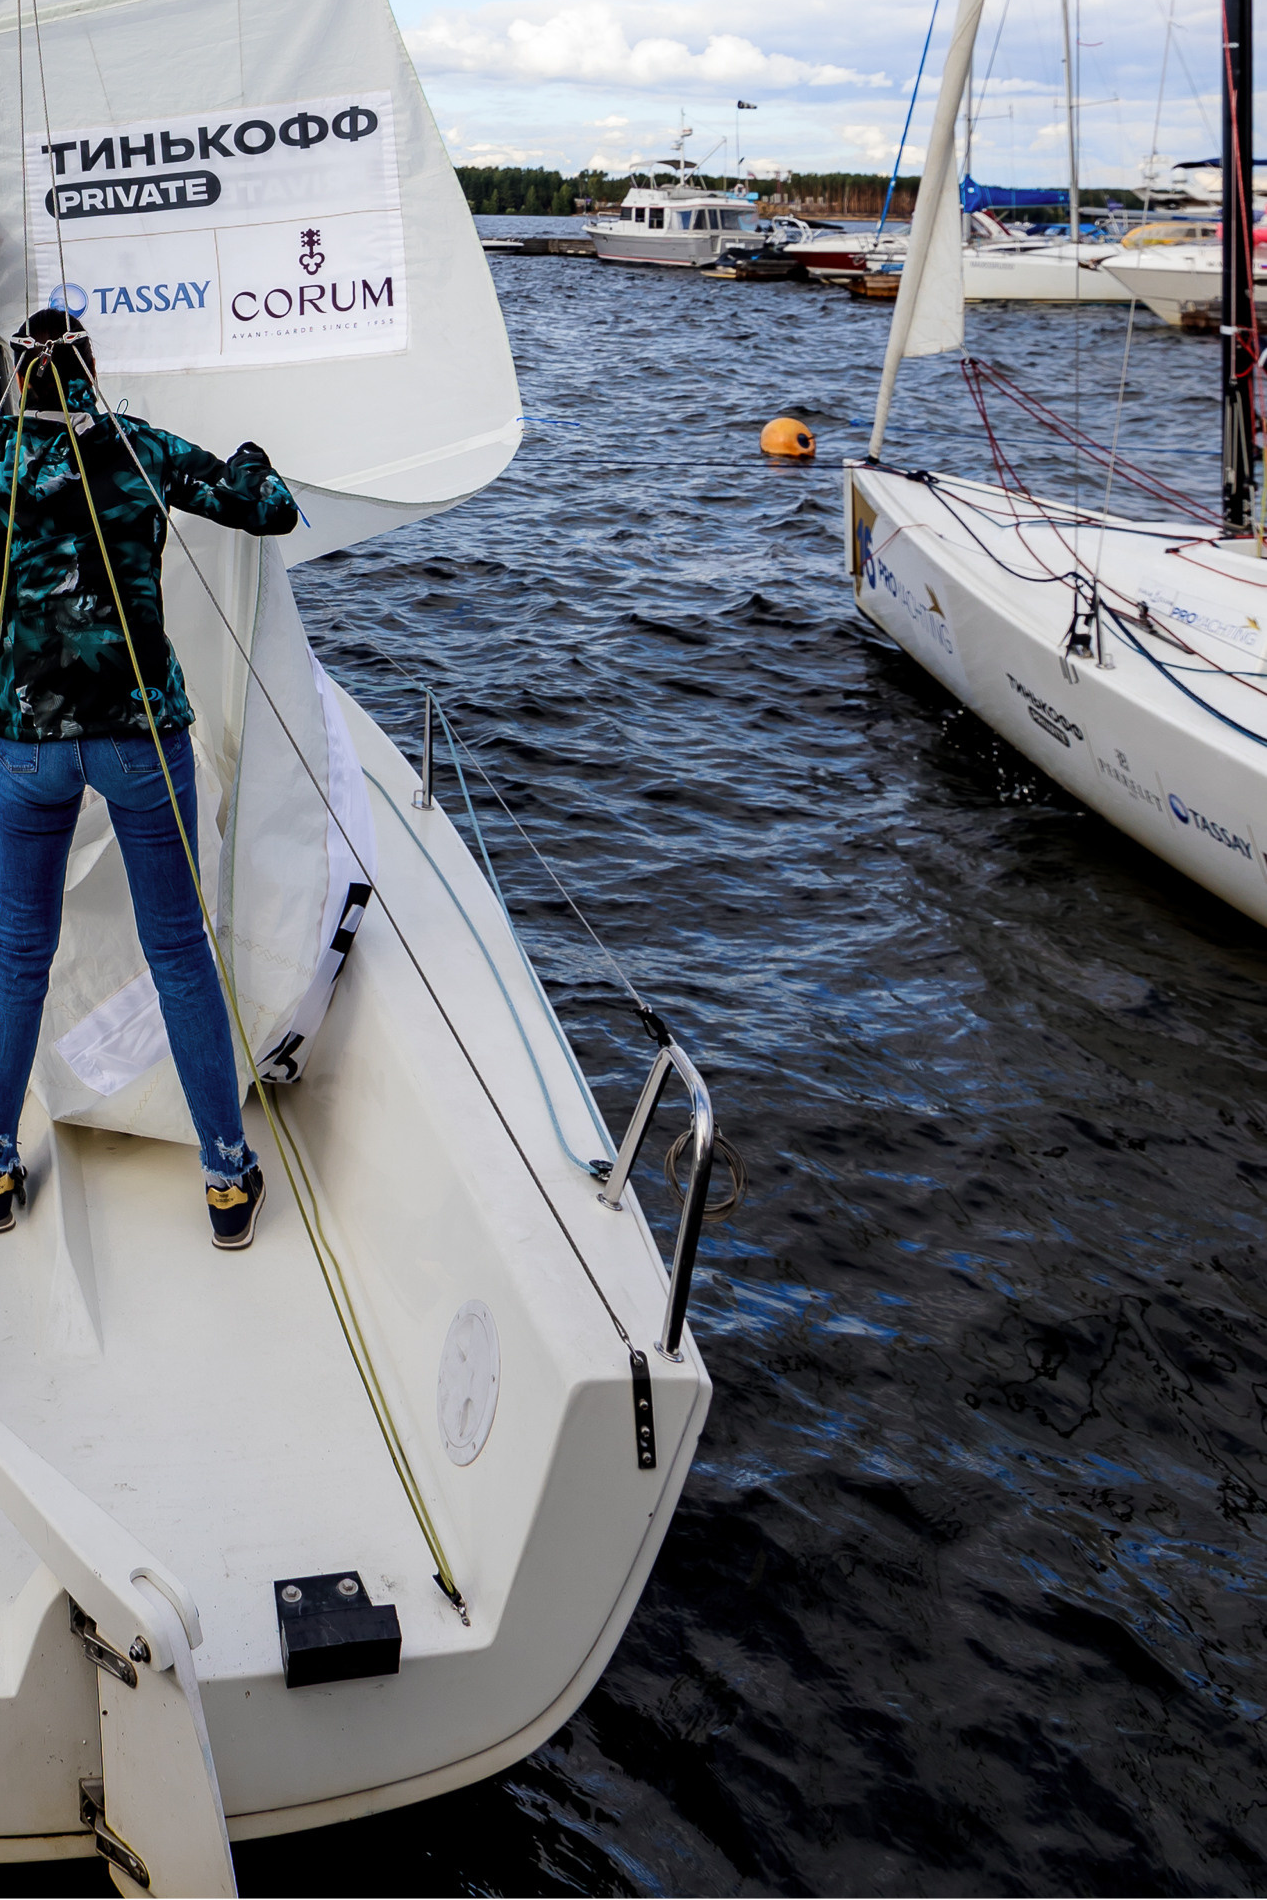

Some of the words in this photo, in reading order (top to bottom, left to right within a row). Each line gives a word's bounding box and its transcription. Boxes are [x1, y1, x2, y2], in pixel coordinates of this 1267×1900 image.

[42, 105, 379, 175] ТИНЬКОФФ
[58, 177, 209, 214] PRIVATE
[92, 280, 211, 315] TASSAY
[231, 276, 395, 322] CORUM
[231, 326, 314, 340] AVANT-GARDE
[322, 321, 358, 332] SINCE
[1188, 808, 1253, 860] TASSAY
